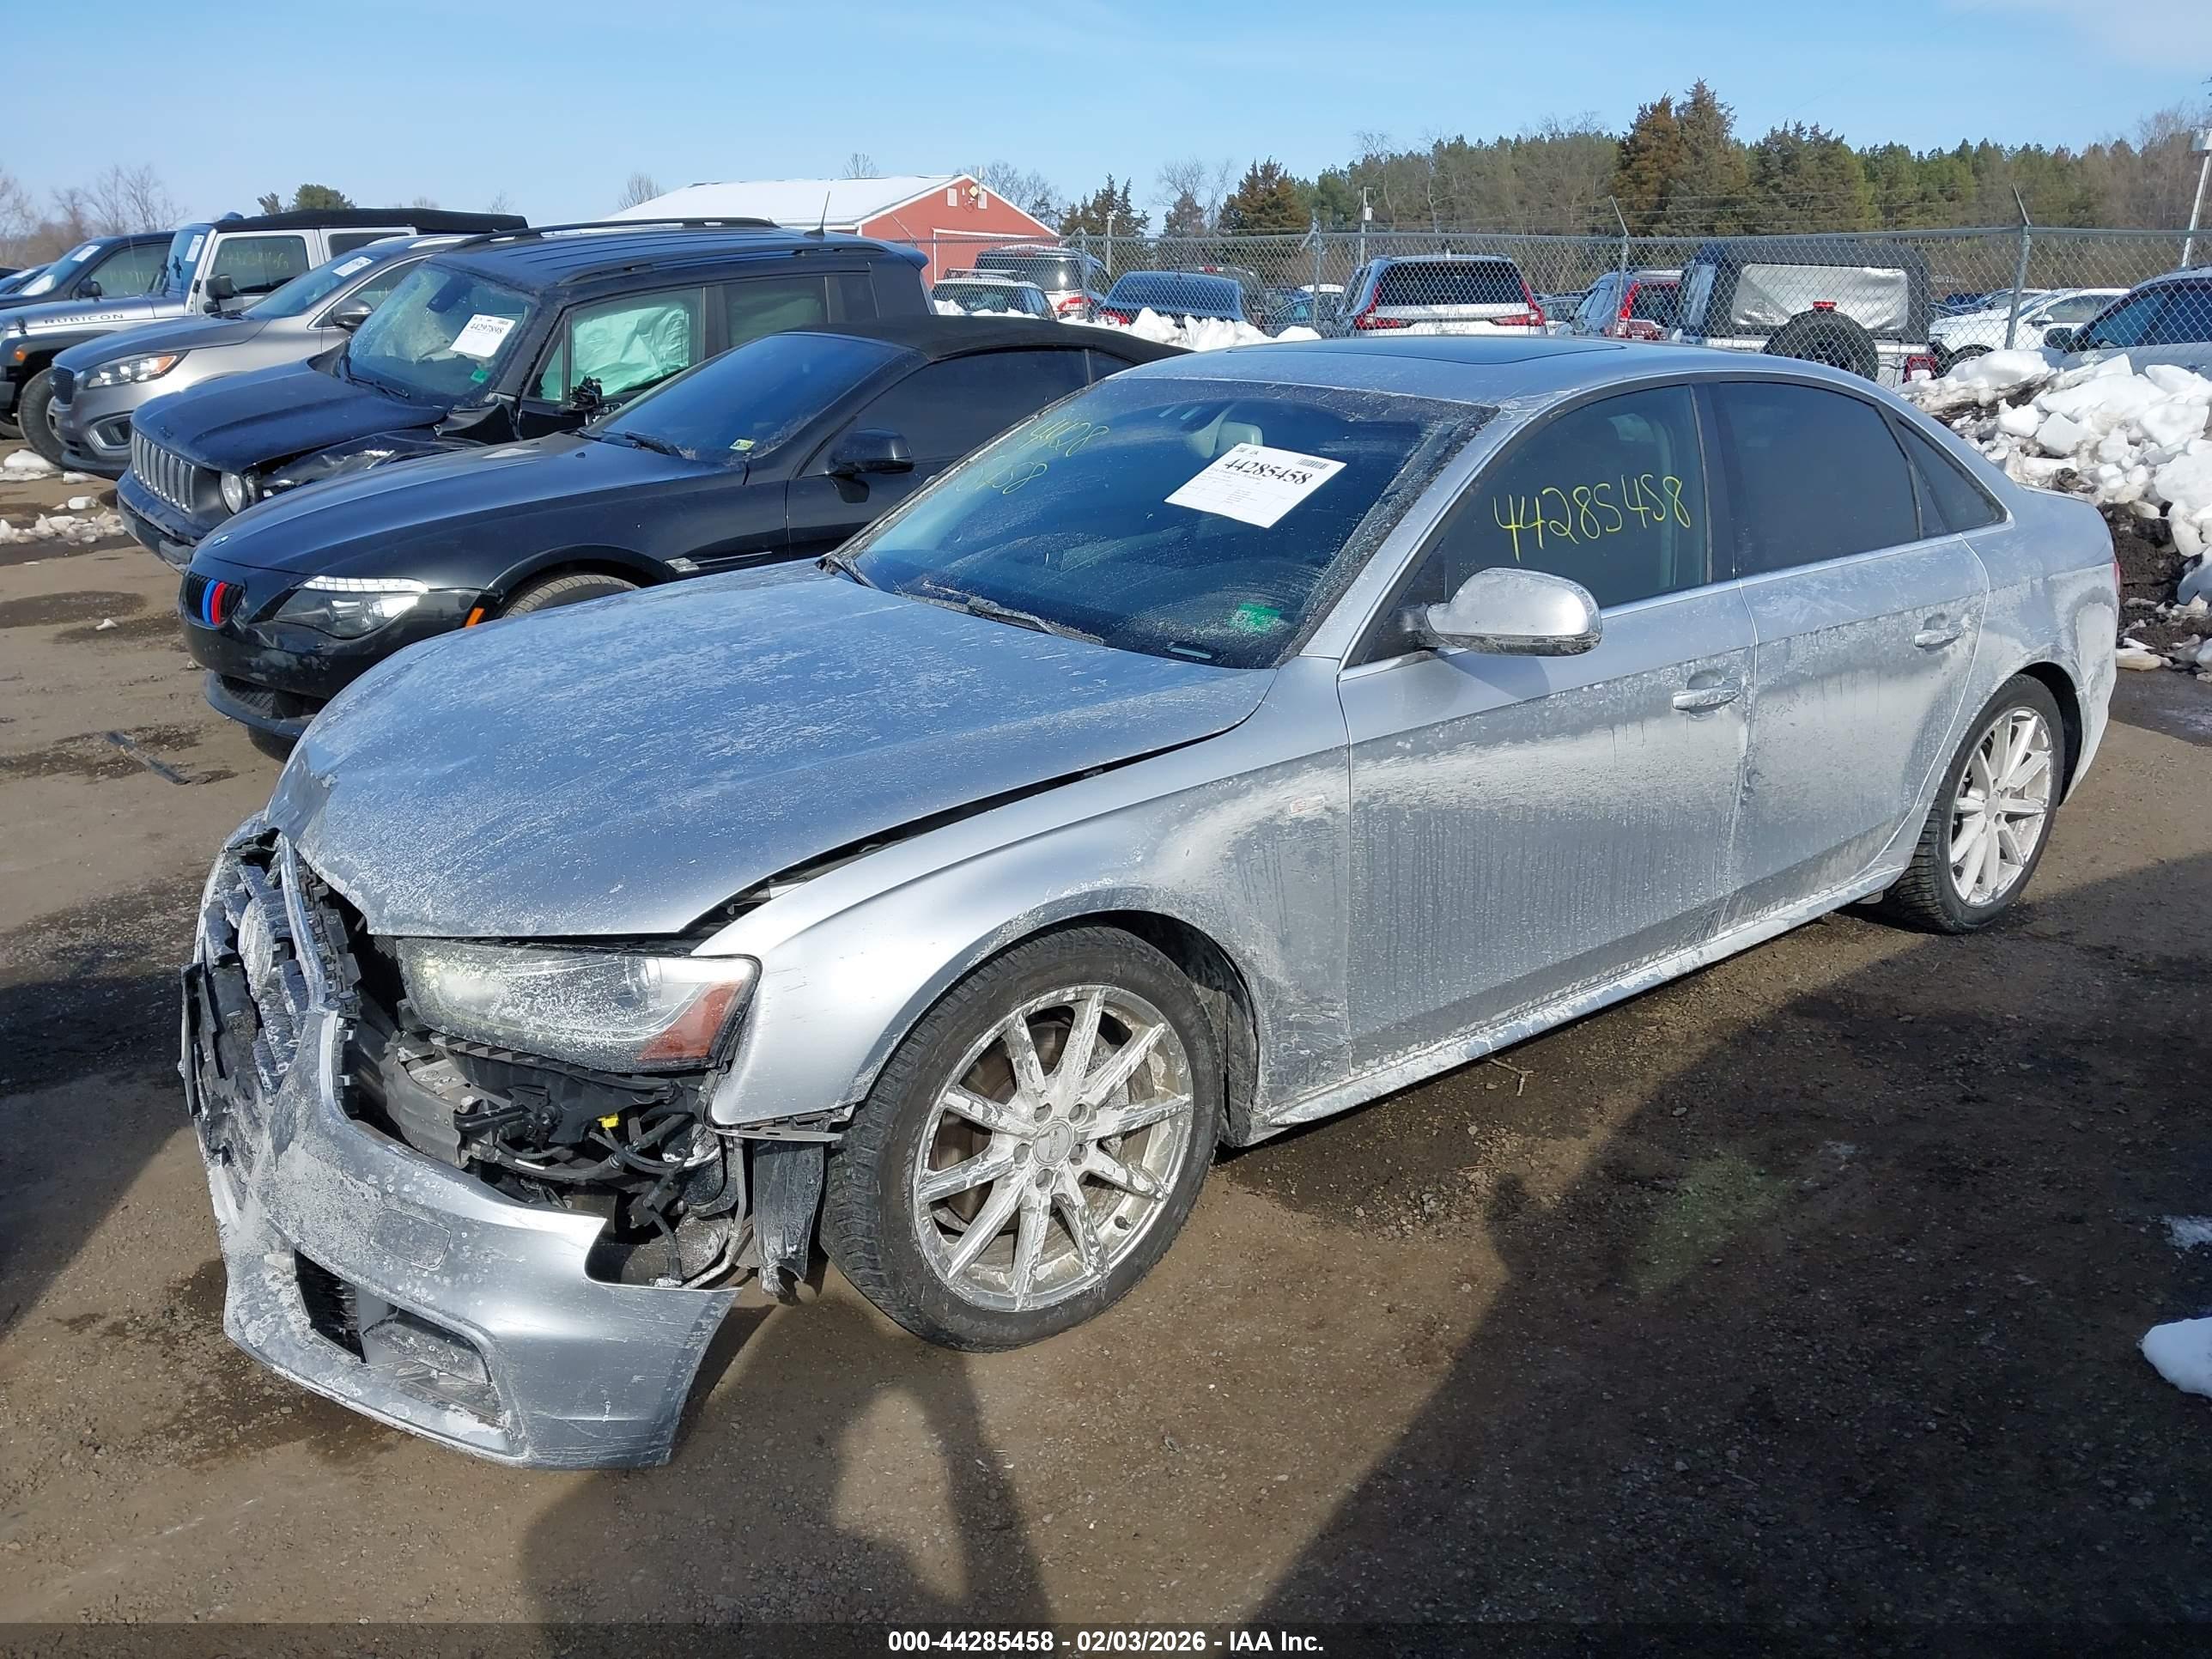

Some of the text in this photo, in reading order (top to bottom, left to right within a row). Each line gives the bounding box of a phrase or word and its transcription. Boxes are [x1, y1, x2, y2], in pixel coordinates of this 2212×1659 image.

[44, 313, 125, 325] RUBICON
[1223, 458, 1314, 486] 44285458
[1492, 473, 1692, 563] 44285458
